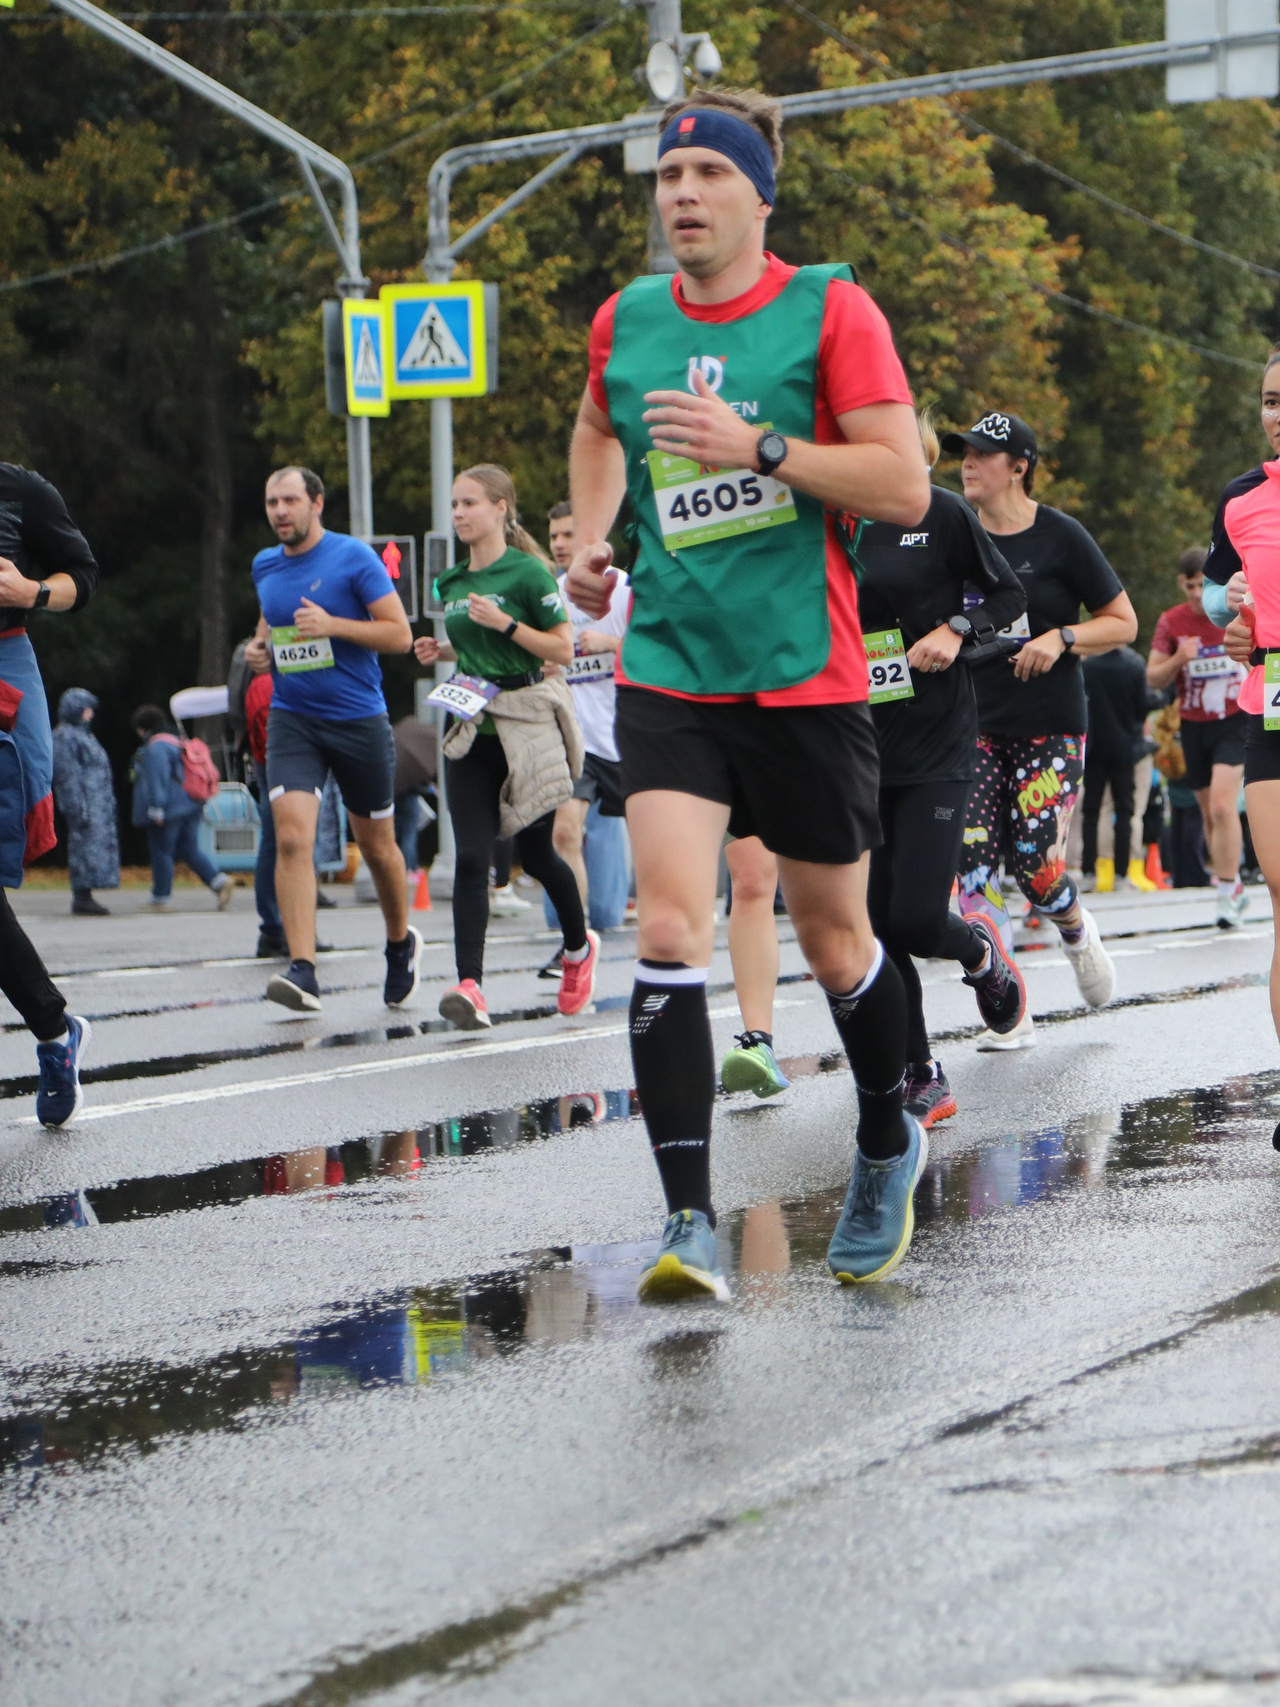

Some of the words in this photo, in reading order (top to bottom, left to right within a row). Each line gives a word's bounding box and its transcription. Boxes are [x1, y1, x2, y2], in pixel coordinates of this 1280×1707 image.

[669, 475, 763, 522] 4605
[899, 532, 930, 547] ДРТ
[279, 644, 319, 661] 4626
[868, 663, 905, 688] 92
[1017, 766, 1061, 818] POW
[960, 864, 991, 896] ZAP
